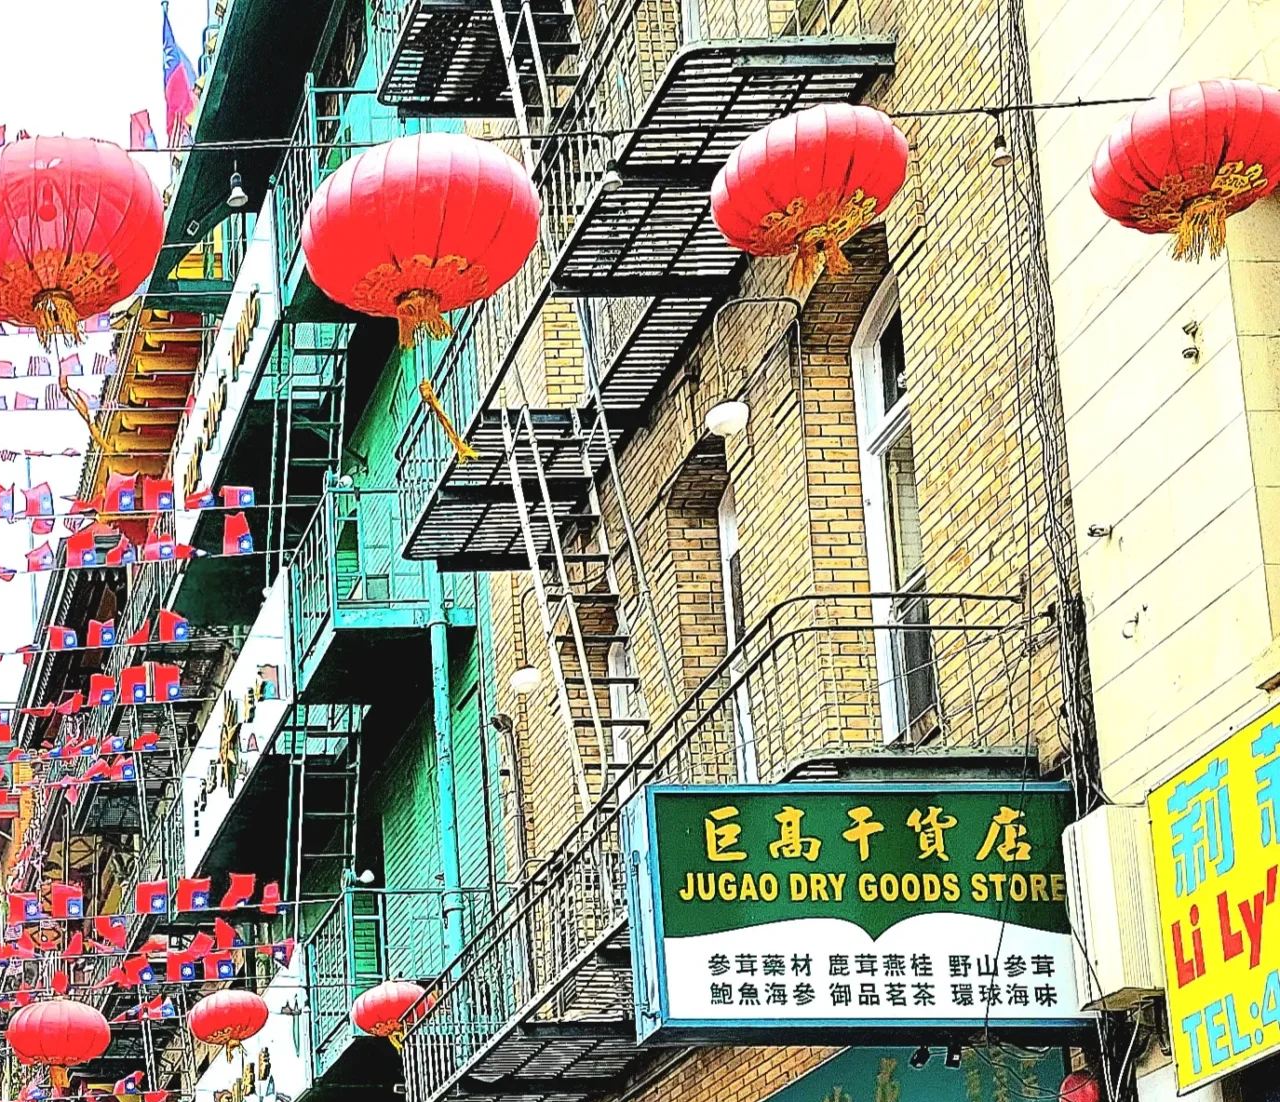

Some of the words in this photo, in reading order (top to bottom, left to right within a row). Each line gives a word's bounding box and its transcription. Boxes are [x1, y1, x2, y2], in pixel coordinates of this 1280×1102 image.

[679, 872, 778, 902] JUGAO
[781, 872, 846, 901] DRY
[858, 872, 960, 902] GOODS
[971, 872, 1066, 902] STORE
